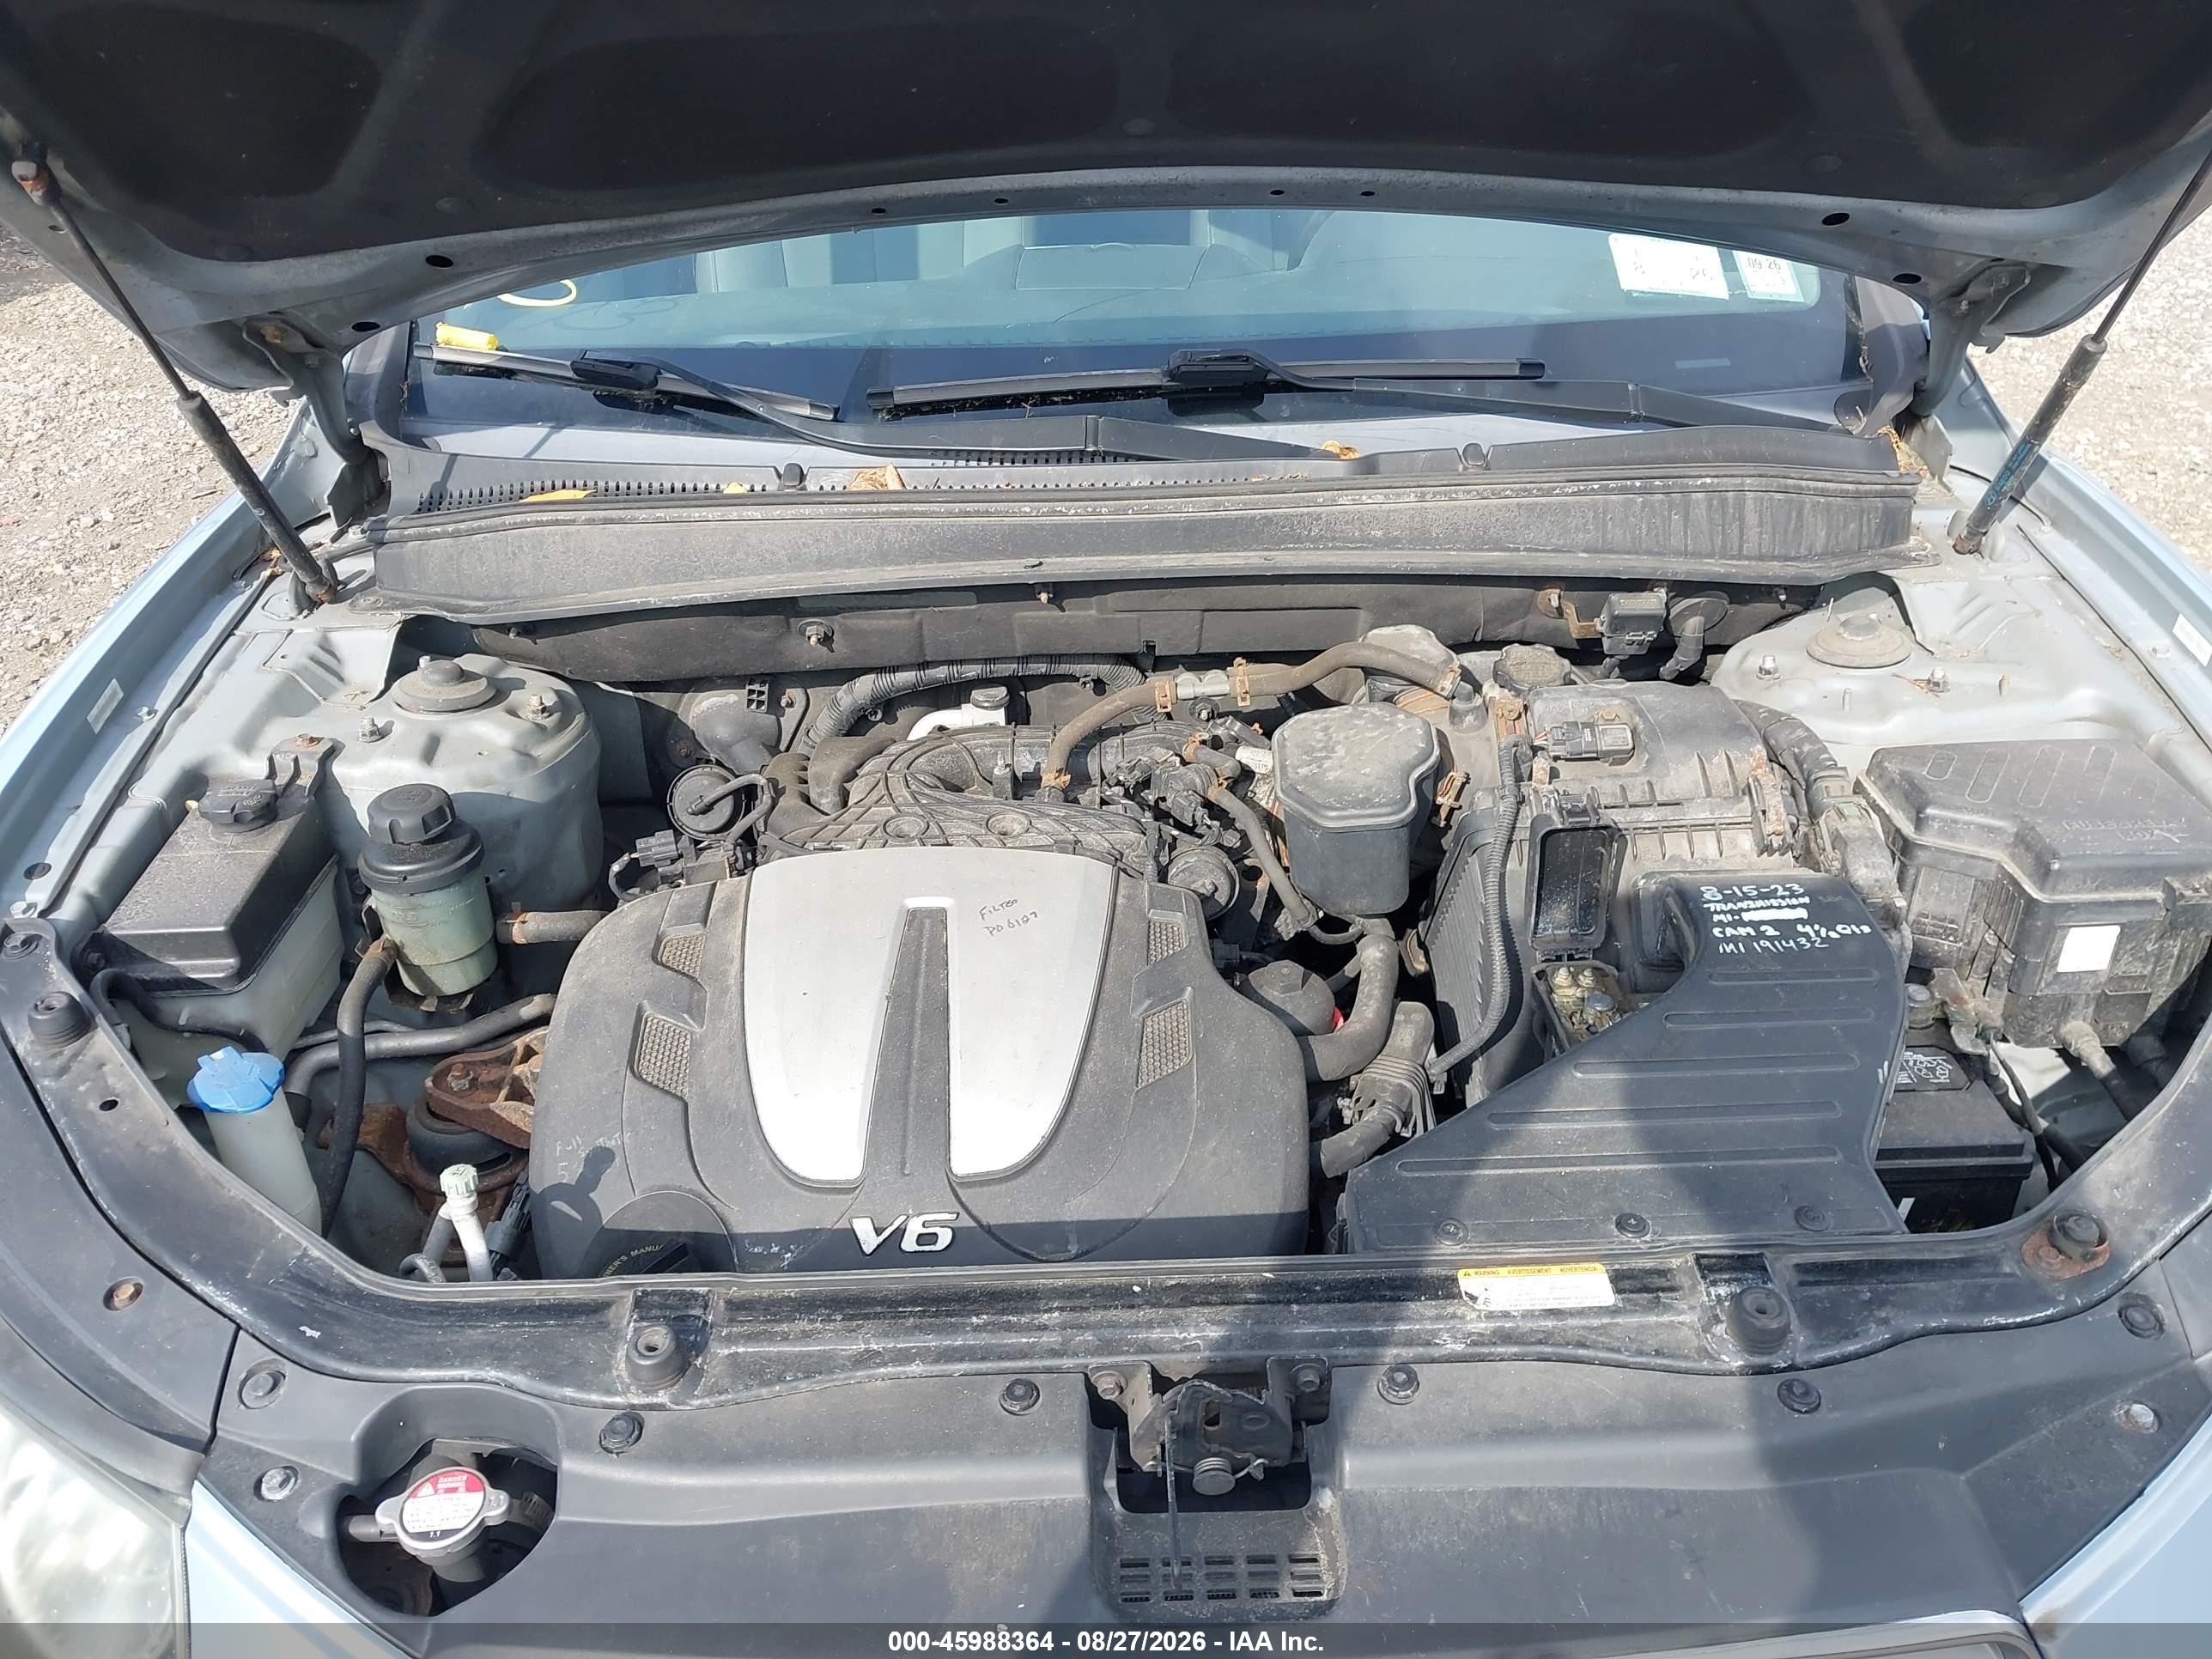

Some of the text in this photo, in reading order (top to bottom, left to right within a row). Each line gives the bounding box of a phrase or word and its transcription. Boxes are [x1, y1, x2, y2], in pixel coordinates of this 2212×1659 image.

[1766, 258, 1782, 270] 26
[1699, 883, 1805, 901] 8-15-23
[1712, 926, 1757, 938] CAM
[1759, 925, 1782, 937] 2
[1753, 936, 1830, 954] 191432
[848, 1212, 960, 1256] V6
[630, 1244, 662, 1257] MANU
